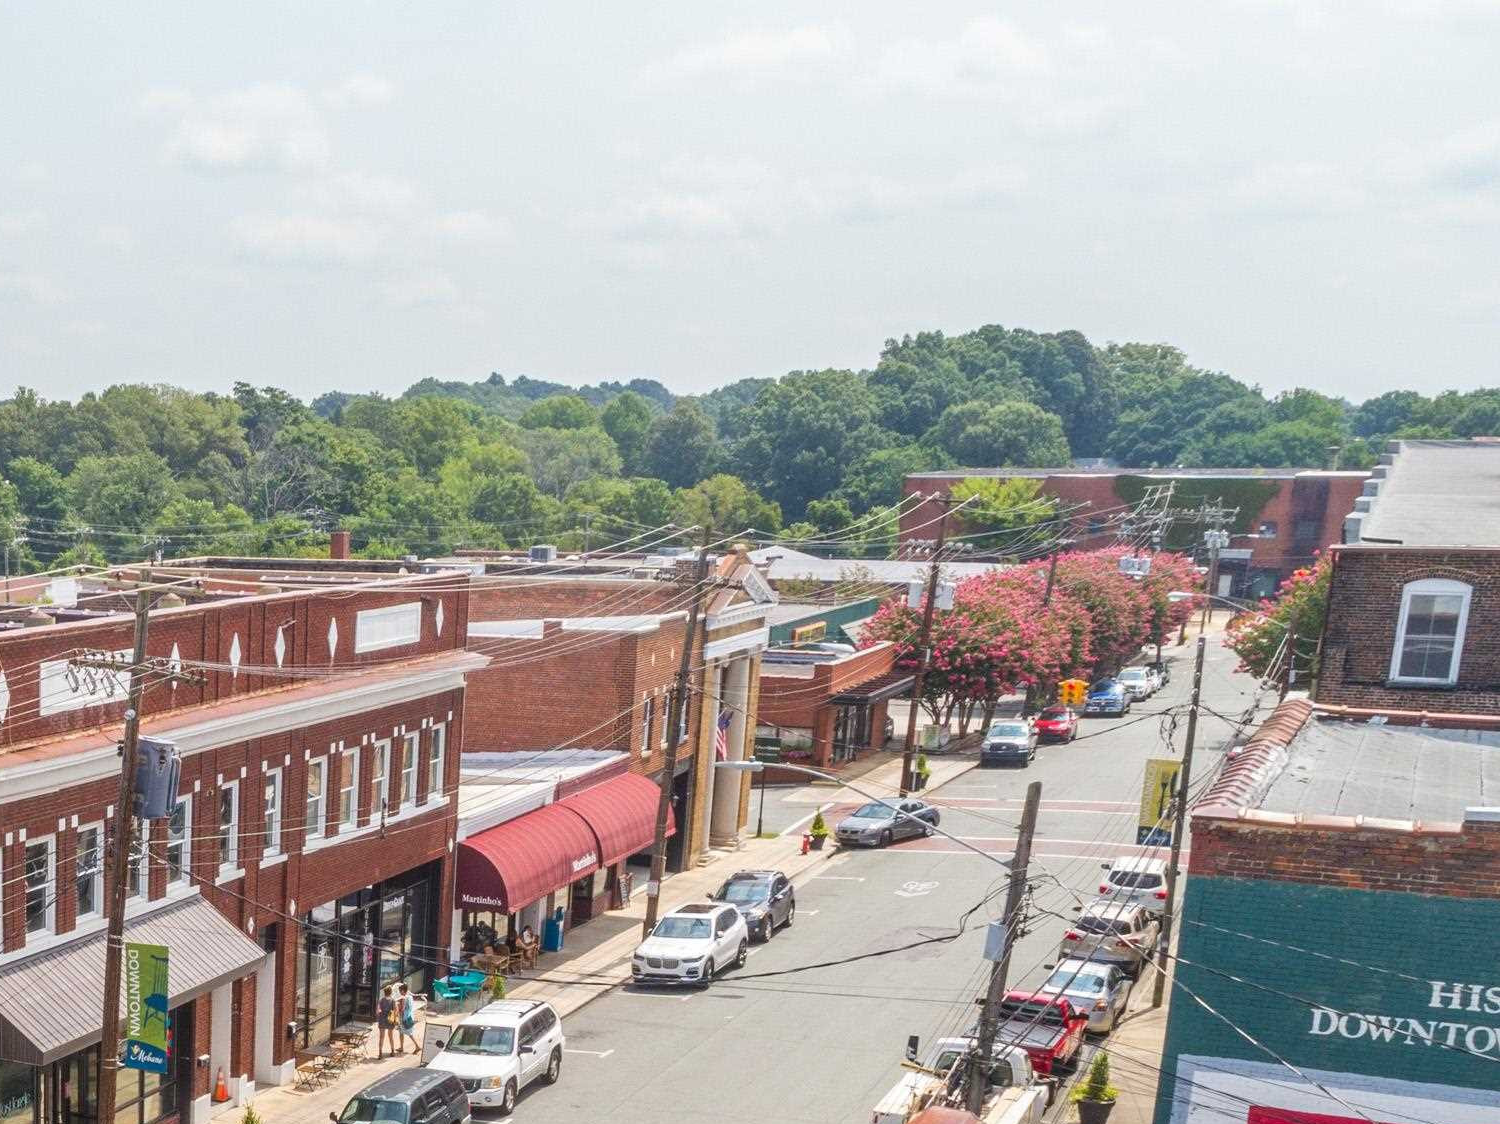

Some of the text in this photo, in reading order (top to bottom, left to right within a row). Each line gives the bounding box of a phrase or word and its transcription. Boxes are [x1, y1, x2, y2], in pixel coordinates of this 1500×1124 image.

[462, 894, 502, 906] Martinho's
[129, 950, 141, 1037] DOWNTOWN
[1309, 1008, 1500, 1053] DOWNTO
